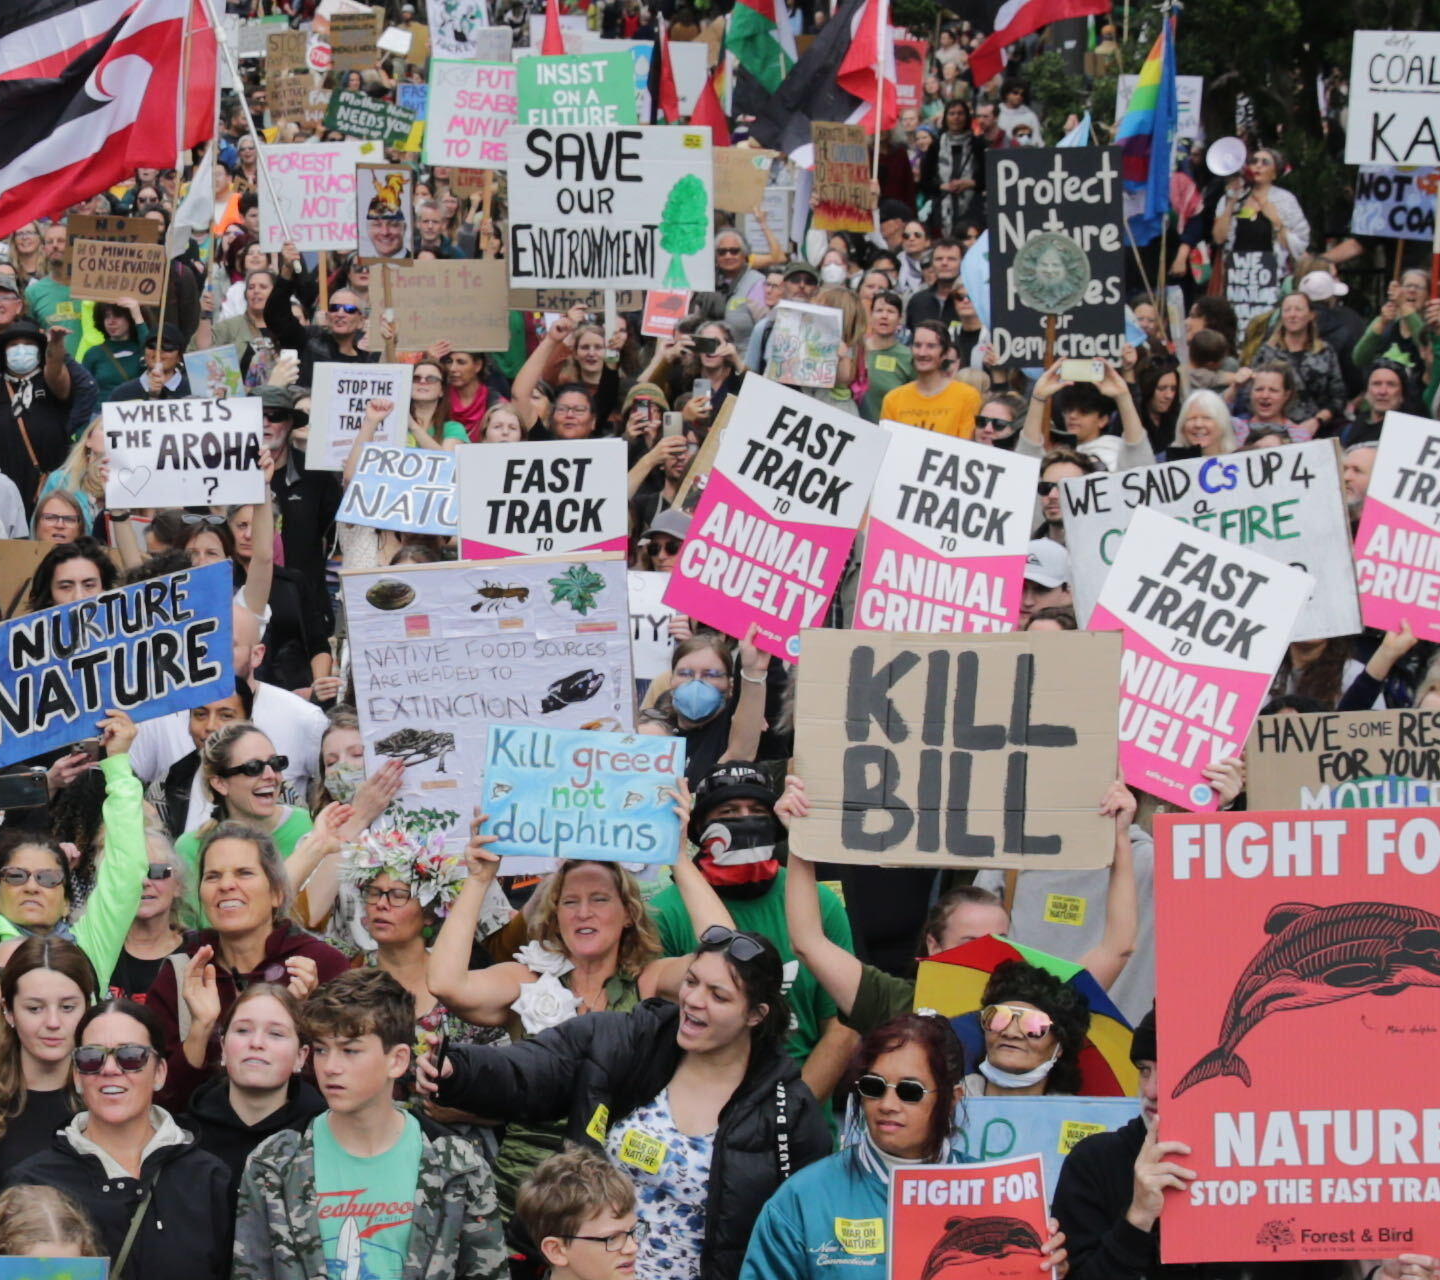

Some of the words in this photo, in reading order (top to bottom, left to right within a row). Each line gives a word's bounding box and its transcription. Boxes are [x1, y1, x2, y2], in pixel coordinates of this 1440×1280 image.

[536, 61, 609, 85] INSIST
[553, 90, 580, 107] ON
[585, 89, 600, 105] A
[528, 106, 618, 125] FUTURE
[525, 129, 643, 183] SAVE
[996, 151, 1118, 207] Protect
[1358, 171, 1405, 202] NOT
[557, 187, 615, 215] OUR
[77, 259, 162, 276] CONSERVATION
[102, 246, 144, 258] MINING
[511, 224, 658, 280] ENVIRONMENT
[81, 274, 138, 292] LAND!
[994, 328, 1121, 365] Demcracy
[118, 400, 194, 424] WHERE
[201, 398, 232, 422] IS
[108, 429, 152, 451] THE
[156, 430, 261, 471] AROHA
[201, 476, 220, 505] ?
[10, 571, 195, 671] NURTURE
[846, 644, 1079, 748] KILL
[1258, 714, 1340, 755] HAVE
[1348, 721, 1392, 739] SOME
[490, 725, 559, 770] Kill
[571, 739, 678, 791] greed
[1319, 752, 1372, 784] FOR
[550, 779, 605, 811] not
[841, 746, 1062, 856] BILL
[491, 811, 658, 850] dolphins
[1171, 823, 1344, 880] FIGHT
[901, 1176, 984, 1208] FIGHT
[992, 1171, 1039, 1202] FOR
[1191, 1181, 1257, 1207] STOP
[1264, 1178, 1312, 1205] THE
[1319, 1178, 1382, 1203] FAST
[841, 1227, 862, 1239] WAR
[864, 1227, 877, 1237] ON
[1301, 1229, 1354, 1244] Forest
[1361, 1229, 1375, 1244] &
[1379, 1229, 1415, 1244] Bird
